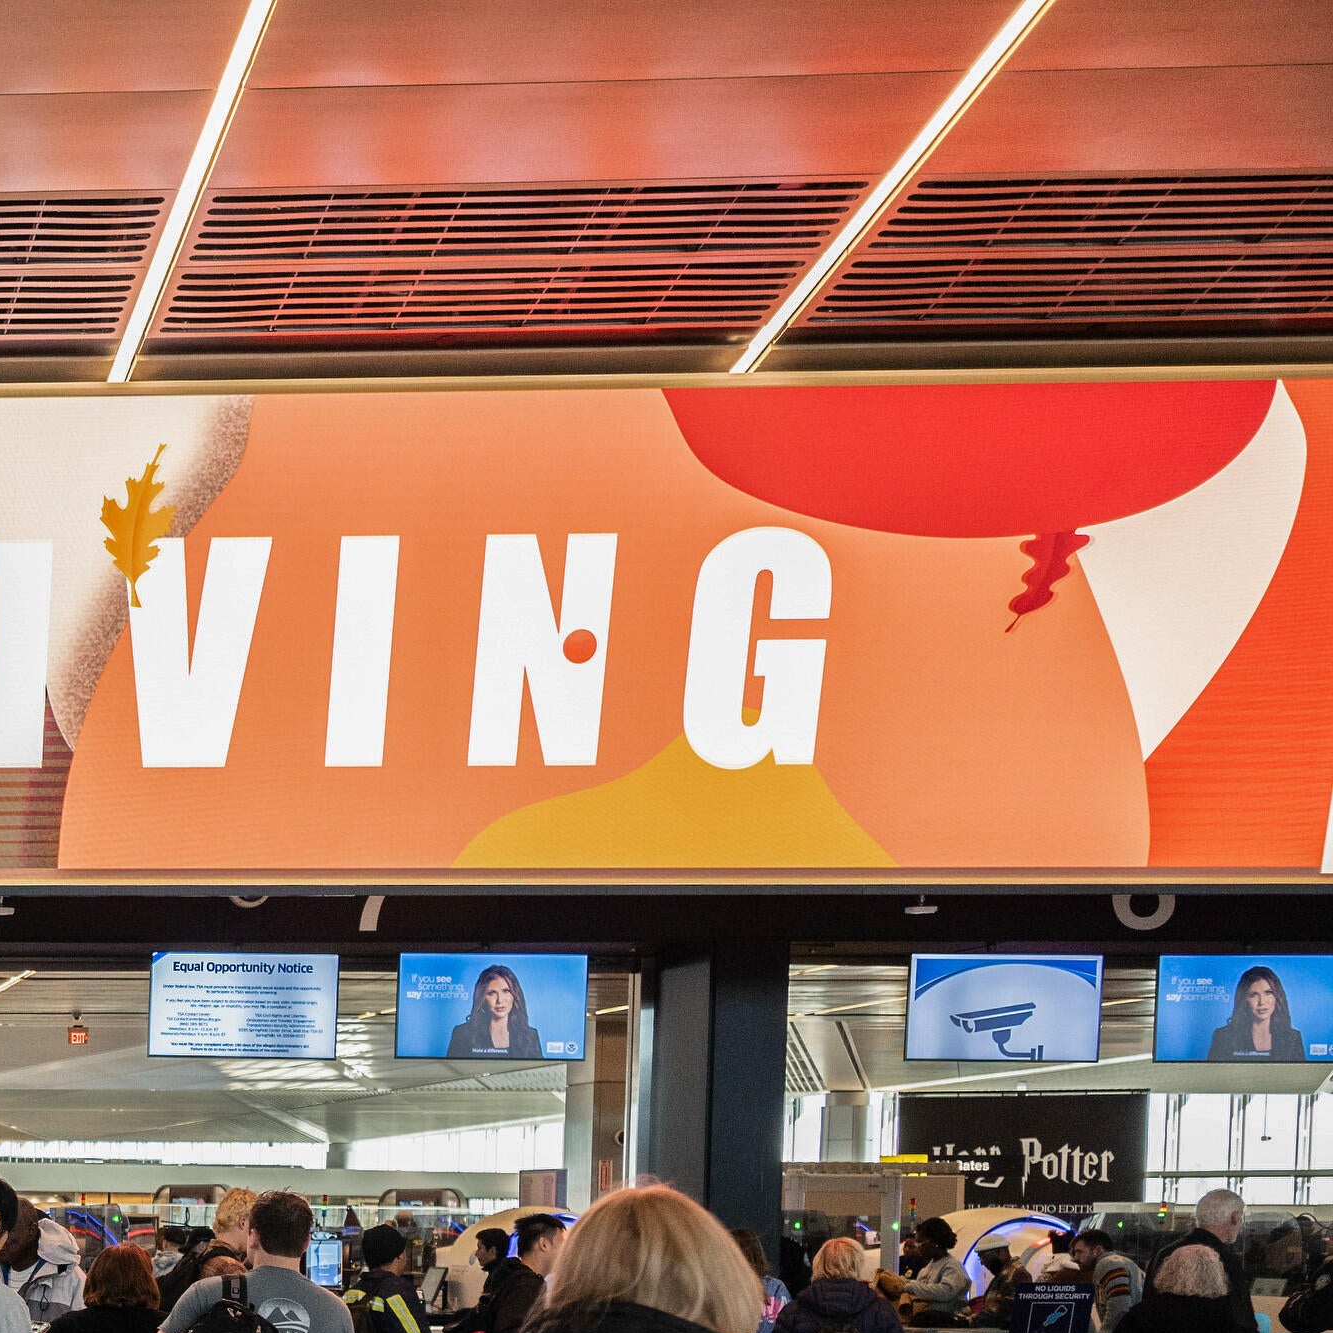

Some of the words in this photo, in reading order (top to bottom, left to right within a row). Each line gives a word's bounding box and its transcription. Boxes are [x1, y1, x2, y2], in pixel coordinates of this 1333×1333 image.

[173, 961, 203, 973] Equal
[207, 961, 275, 974] Opportunity
[277, 962, 313, 973] Notice
[418, 976, 435, 984] you
[406, 991, 421, 1000] say
[422, 991, 469, 1000] something
[1166, 993, 1181, 1002] say
[1182, 992, 1229, 1002] something
[71, 1032, 85, 1044] EXIT
[1020, 1137, 1115, 1197] Potter
